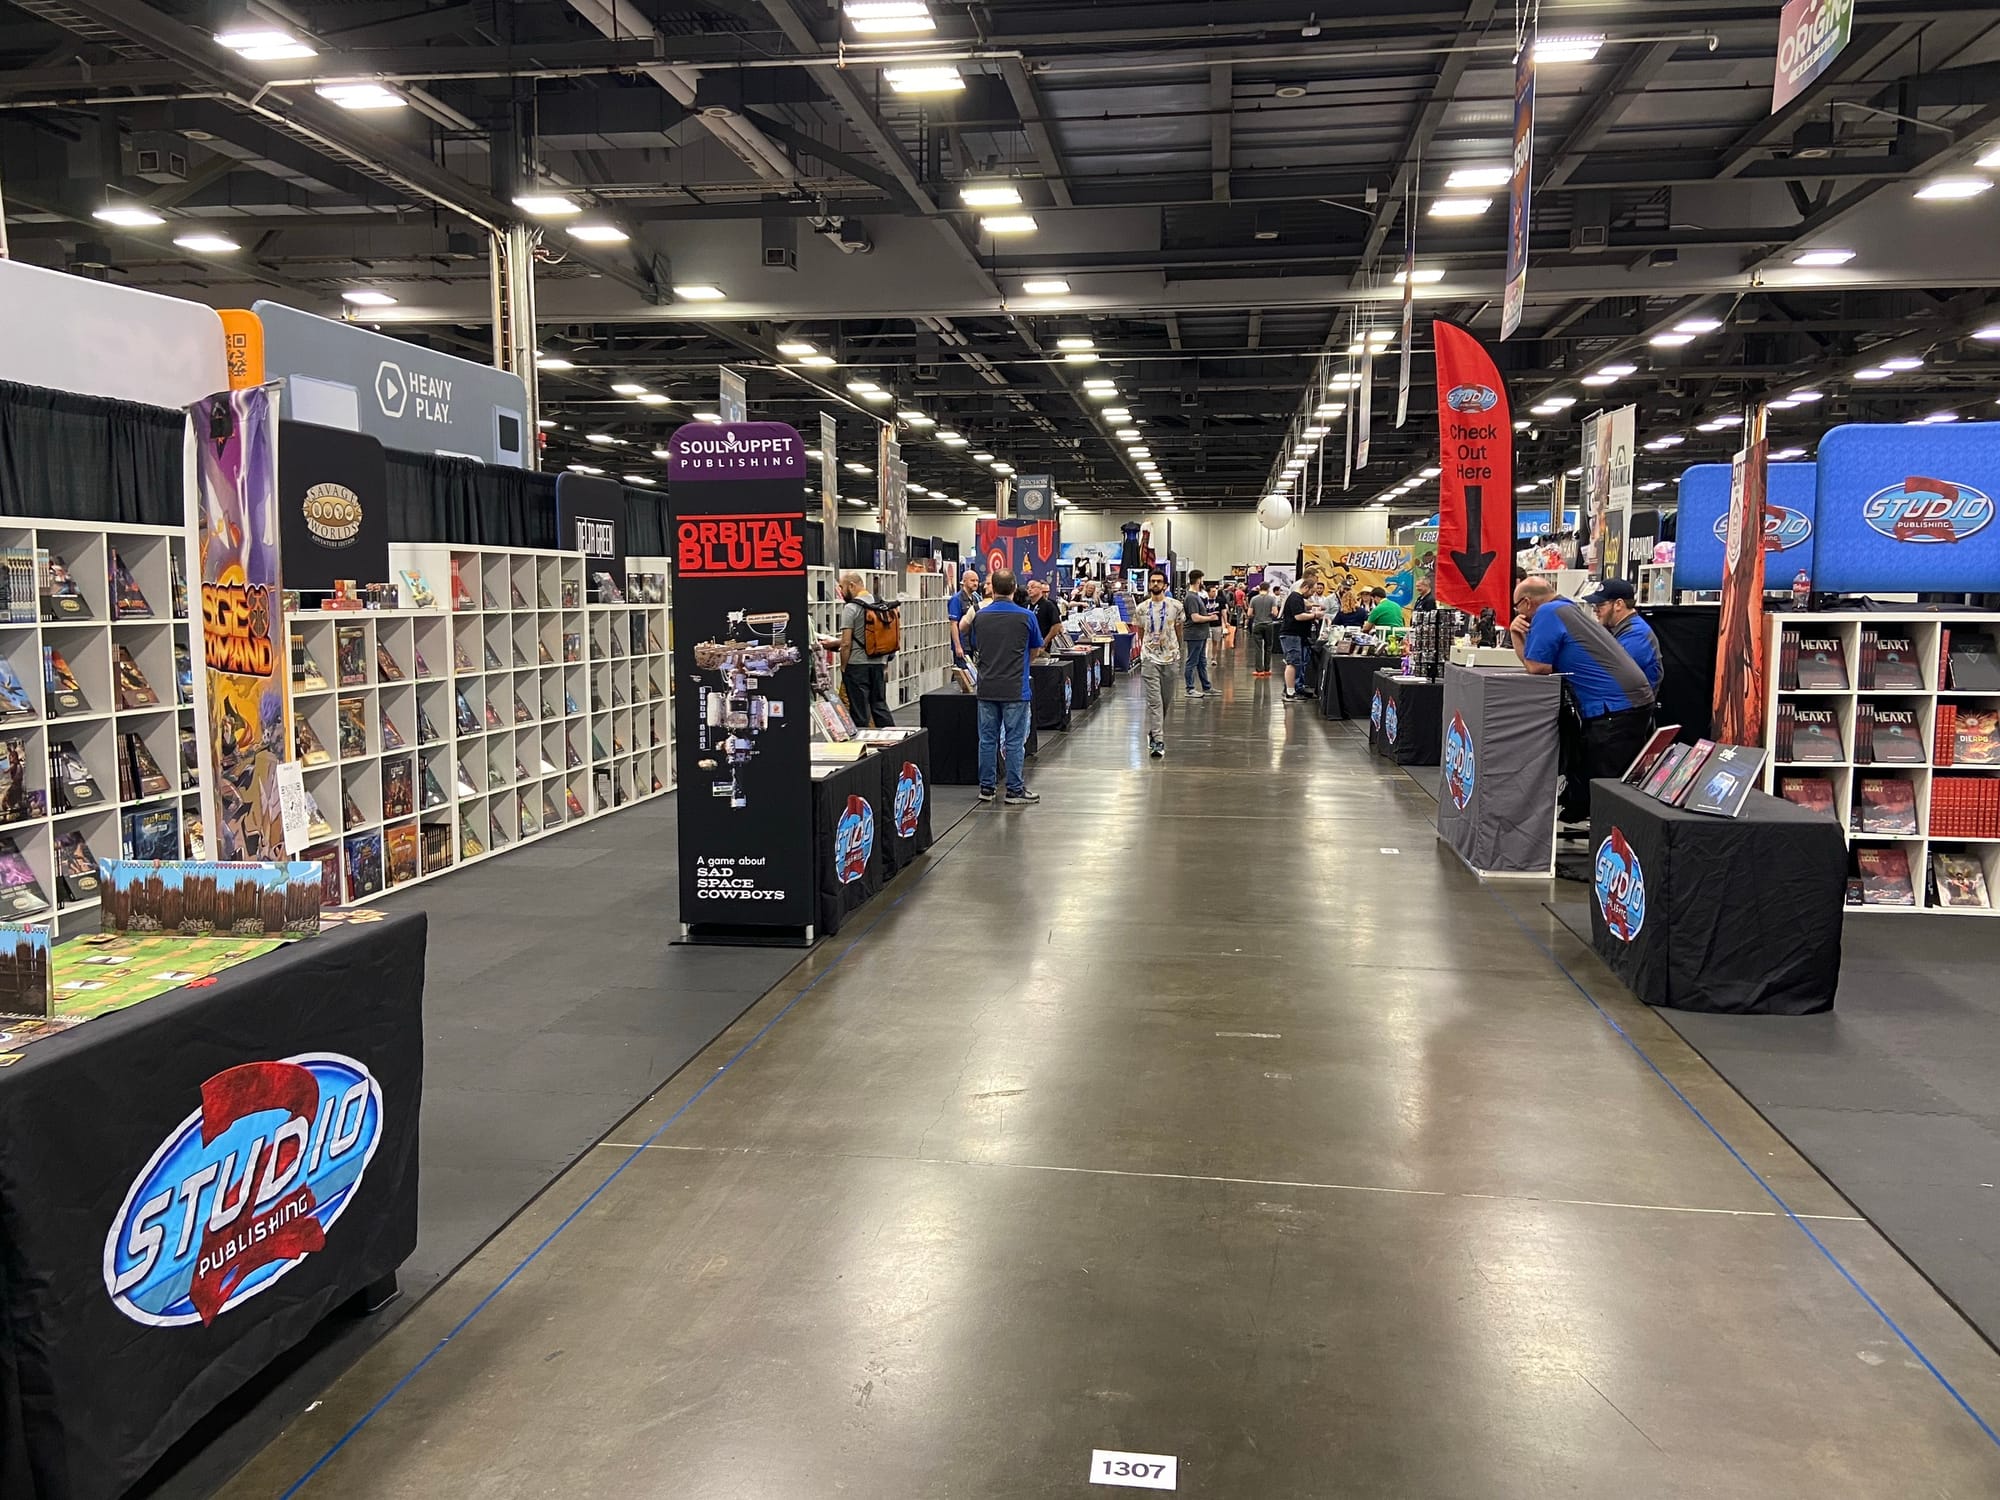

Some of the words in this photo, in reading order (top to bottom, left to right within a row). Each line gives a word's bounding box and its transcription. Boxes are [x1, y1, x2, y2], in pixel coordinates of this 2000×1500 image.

[409, 371, 452, 401] HEAVY
[1448, 392, 1495, 402] STUDIO
[1450, 424, 1497, 440] Check
[680, 437, 793, 454] SOULMUPPET
[1457, 444, 1487, 460] Out
[681, 456, 794, 468] PUBLISHING
[1456, 464, 1491, 479] Here
[309, 484, 359, 506] SAVAGE
[1864, 498, 1988, 518] STUDIO
[310, 518, 359, 539] WORLDS
[678, 521, 803, 544] ORBITAL
[678, 541, 804, 570] BLUES
[1346, 548, 1401, 570] LEGENDS
[1800, 639, 1839, 651] HEART
[1794, 711, 1832, 723] HEART
[1874, 711, 1913, 724] HEART
[697, 856, 705, 865] A
[708, 857, 735, 867] game
[738, 856, 766, 866] about
[697, 867, 733, 877] SAD
[697, 878, 754, 888] SPACE
[1596, 856, 1644, 911] STUDIO
[697, 889, 785, 900] COWBOYS
[113, 1078, 370, 1298] STUDIO
[199, 1193, 308, 1279] PUBLISHING
[1103, 1460, 1166, 1479] 1307
